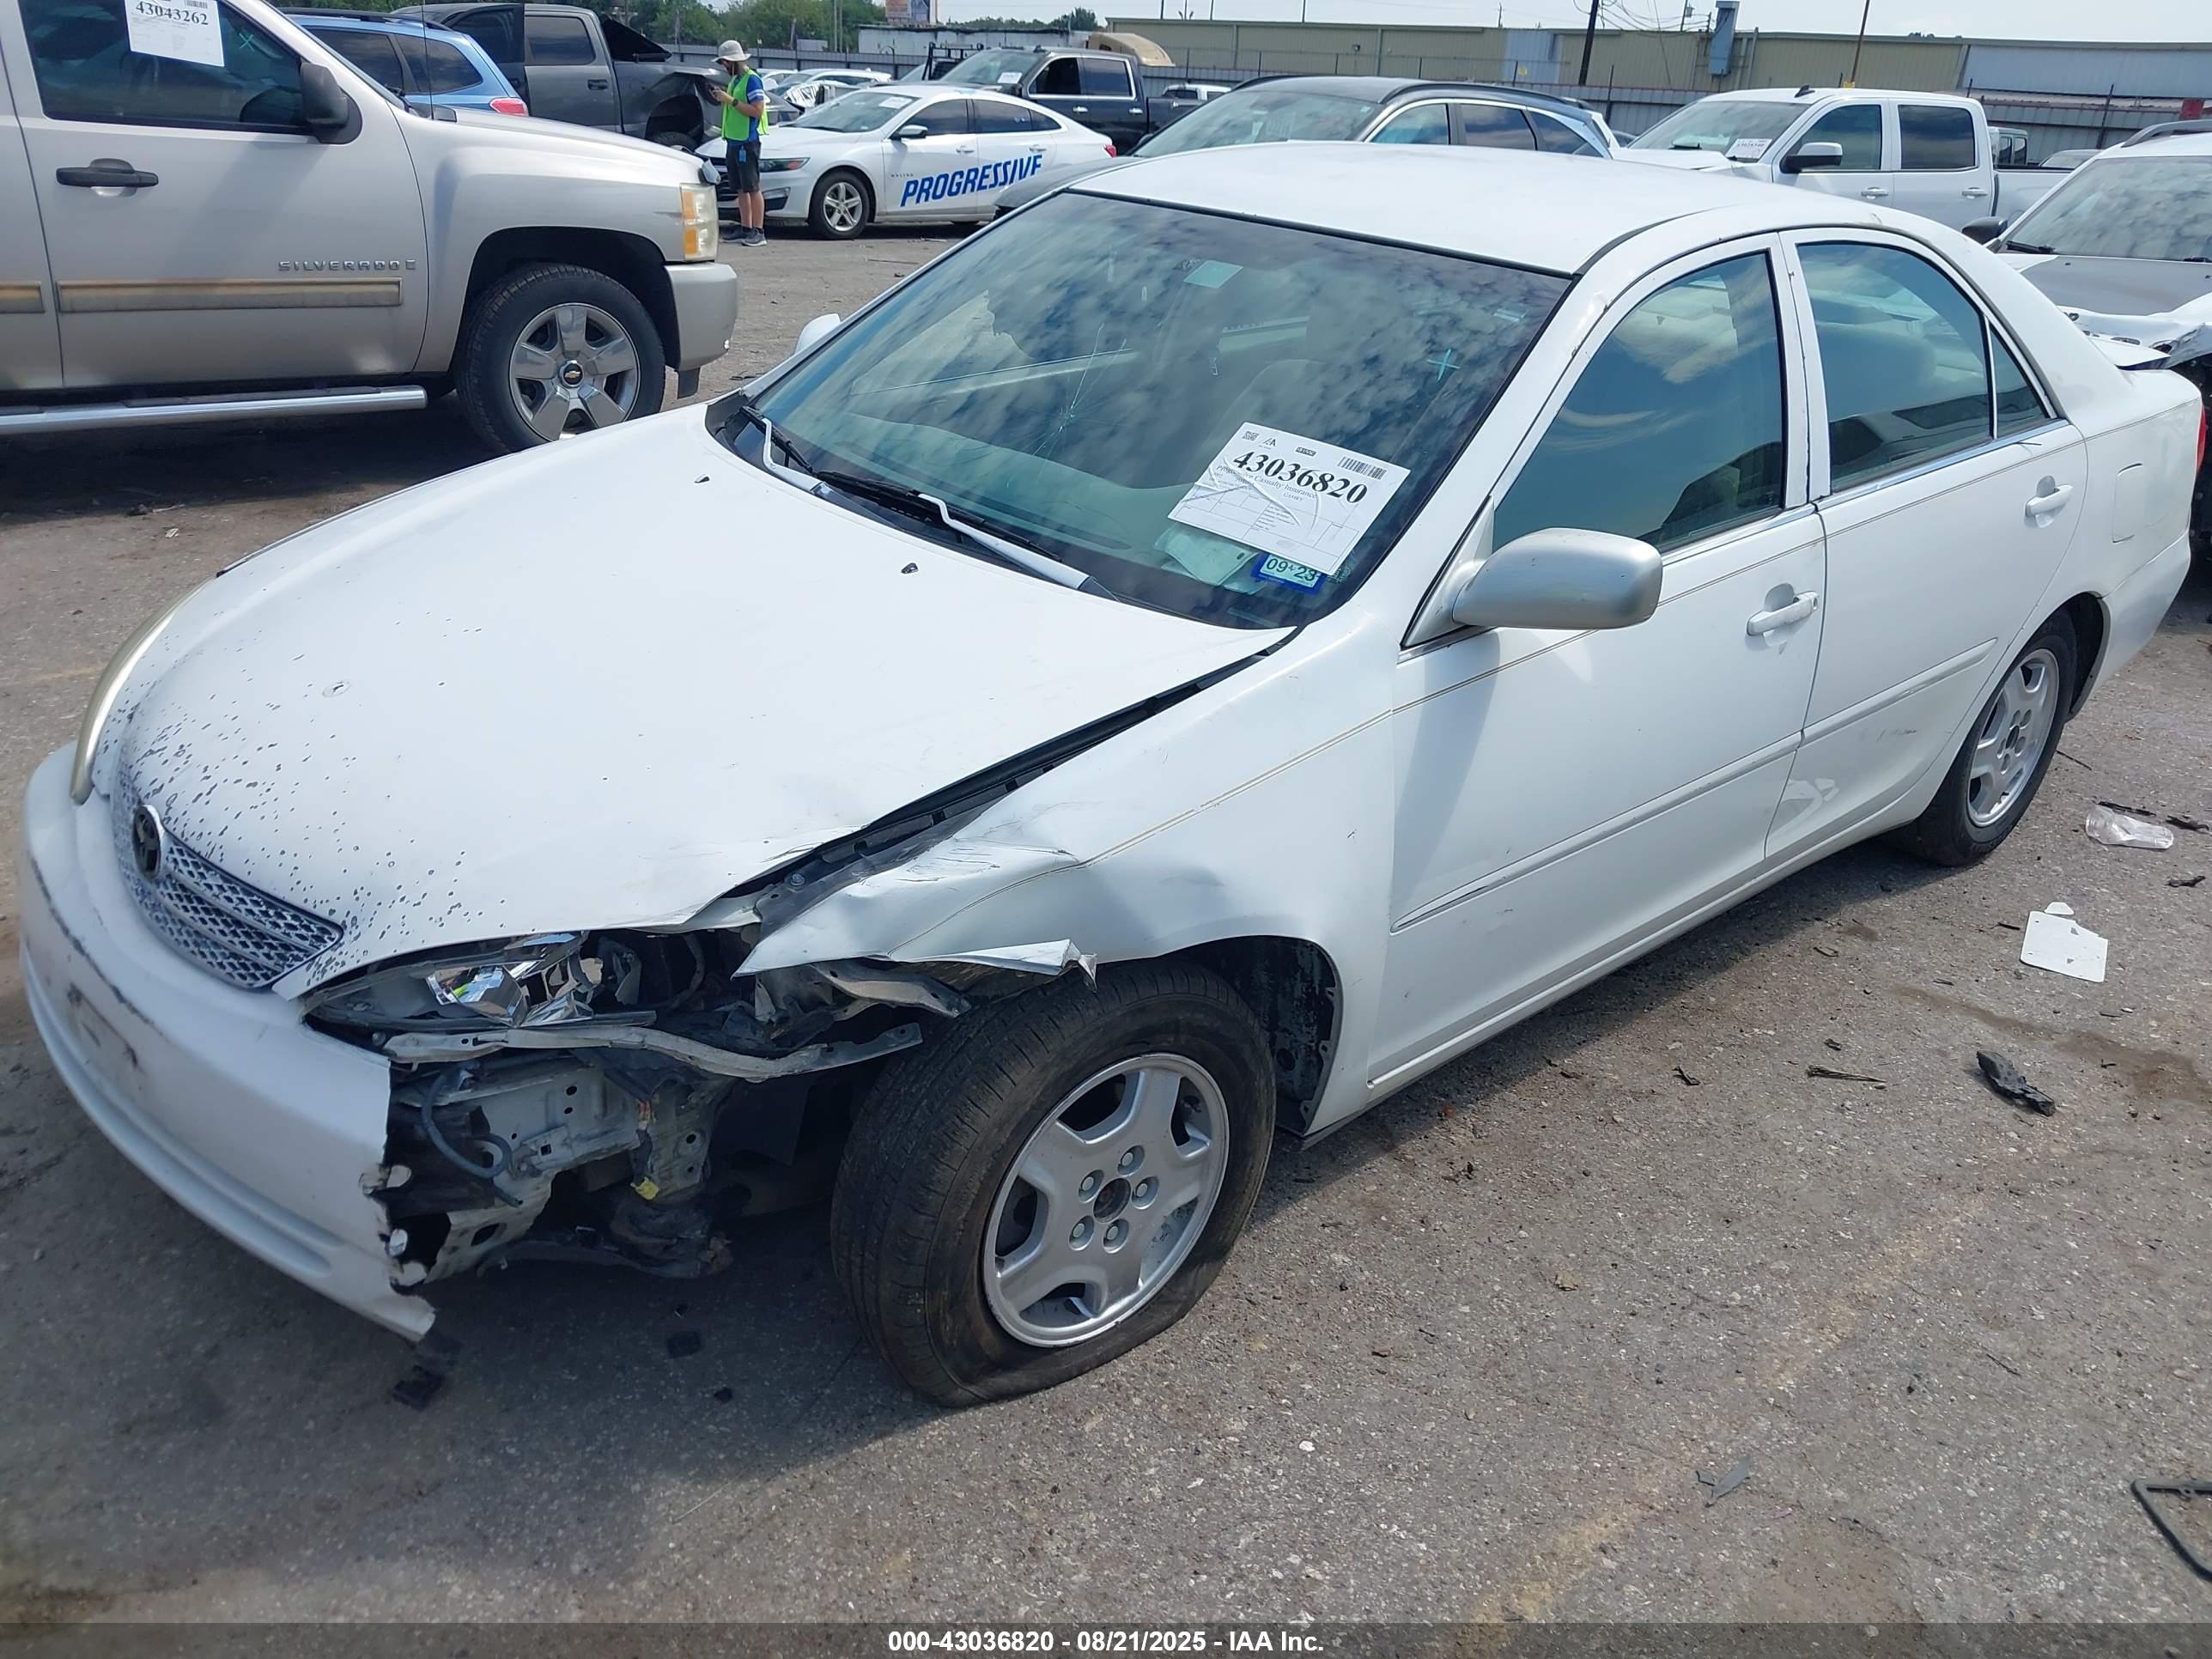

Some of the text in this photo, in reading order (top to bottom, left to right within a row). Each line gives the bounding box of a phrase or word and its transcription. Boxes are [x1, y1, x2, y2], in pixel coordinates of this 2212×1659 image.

[136, 1, 209, 26] 43043262
[900, 155, 1042, 207] PROGRESSIVE
[278, 259, 401, 272] SILVERADO
[1216, 465, 1254, 479] Progrive
[1254, 475, 1282, 489] Casualty
[1285, 483, 1318, 499] Insurance
[1233, 451, 1368, 504] 43036820
